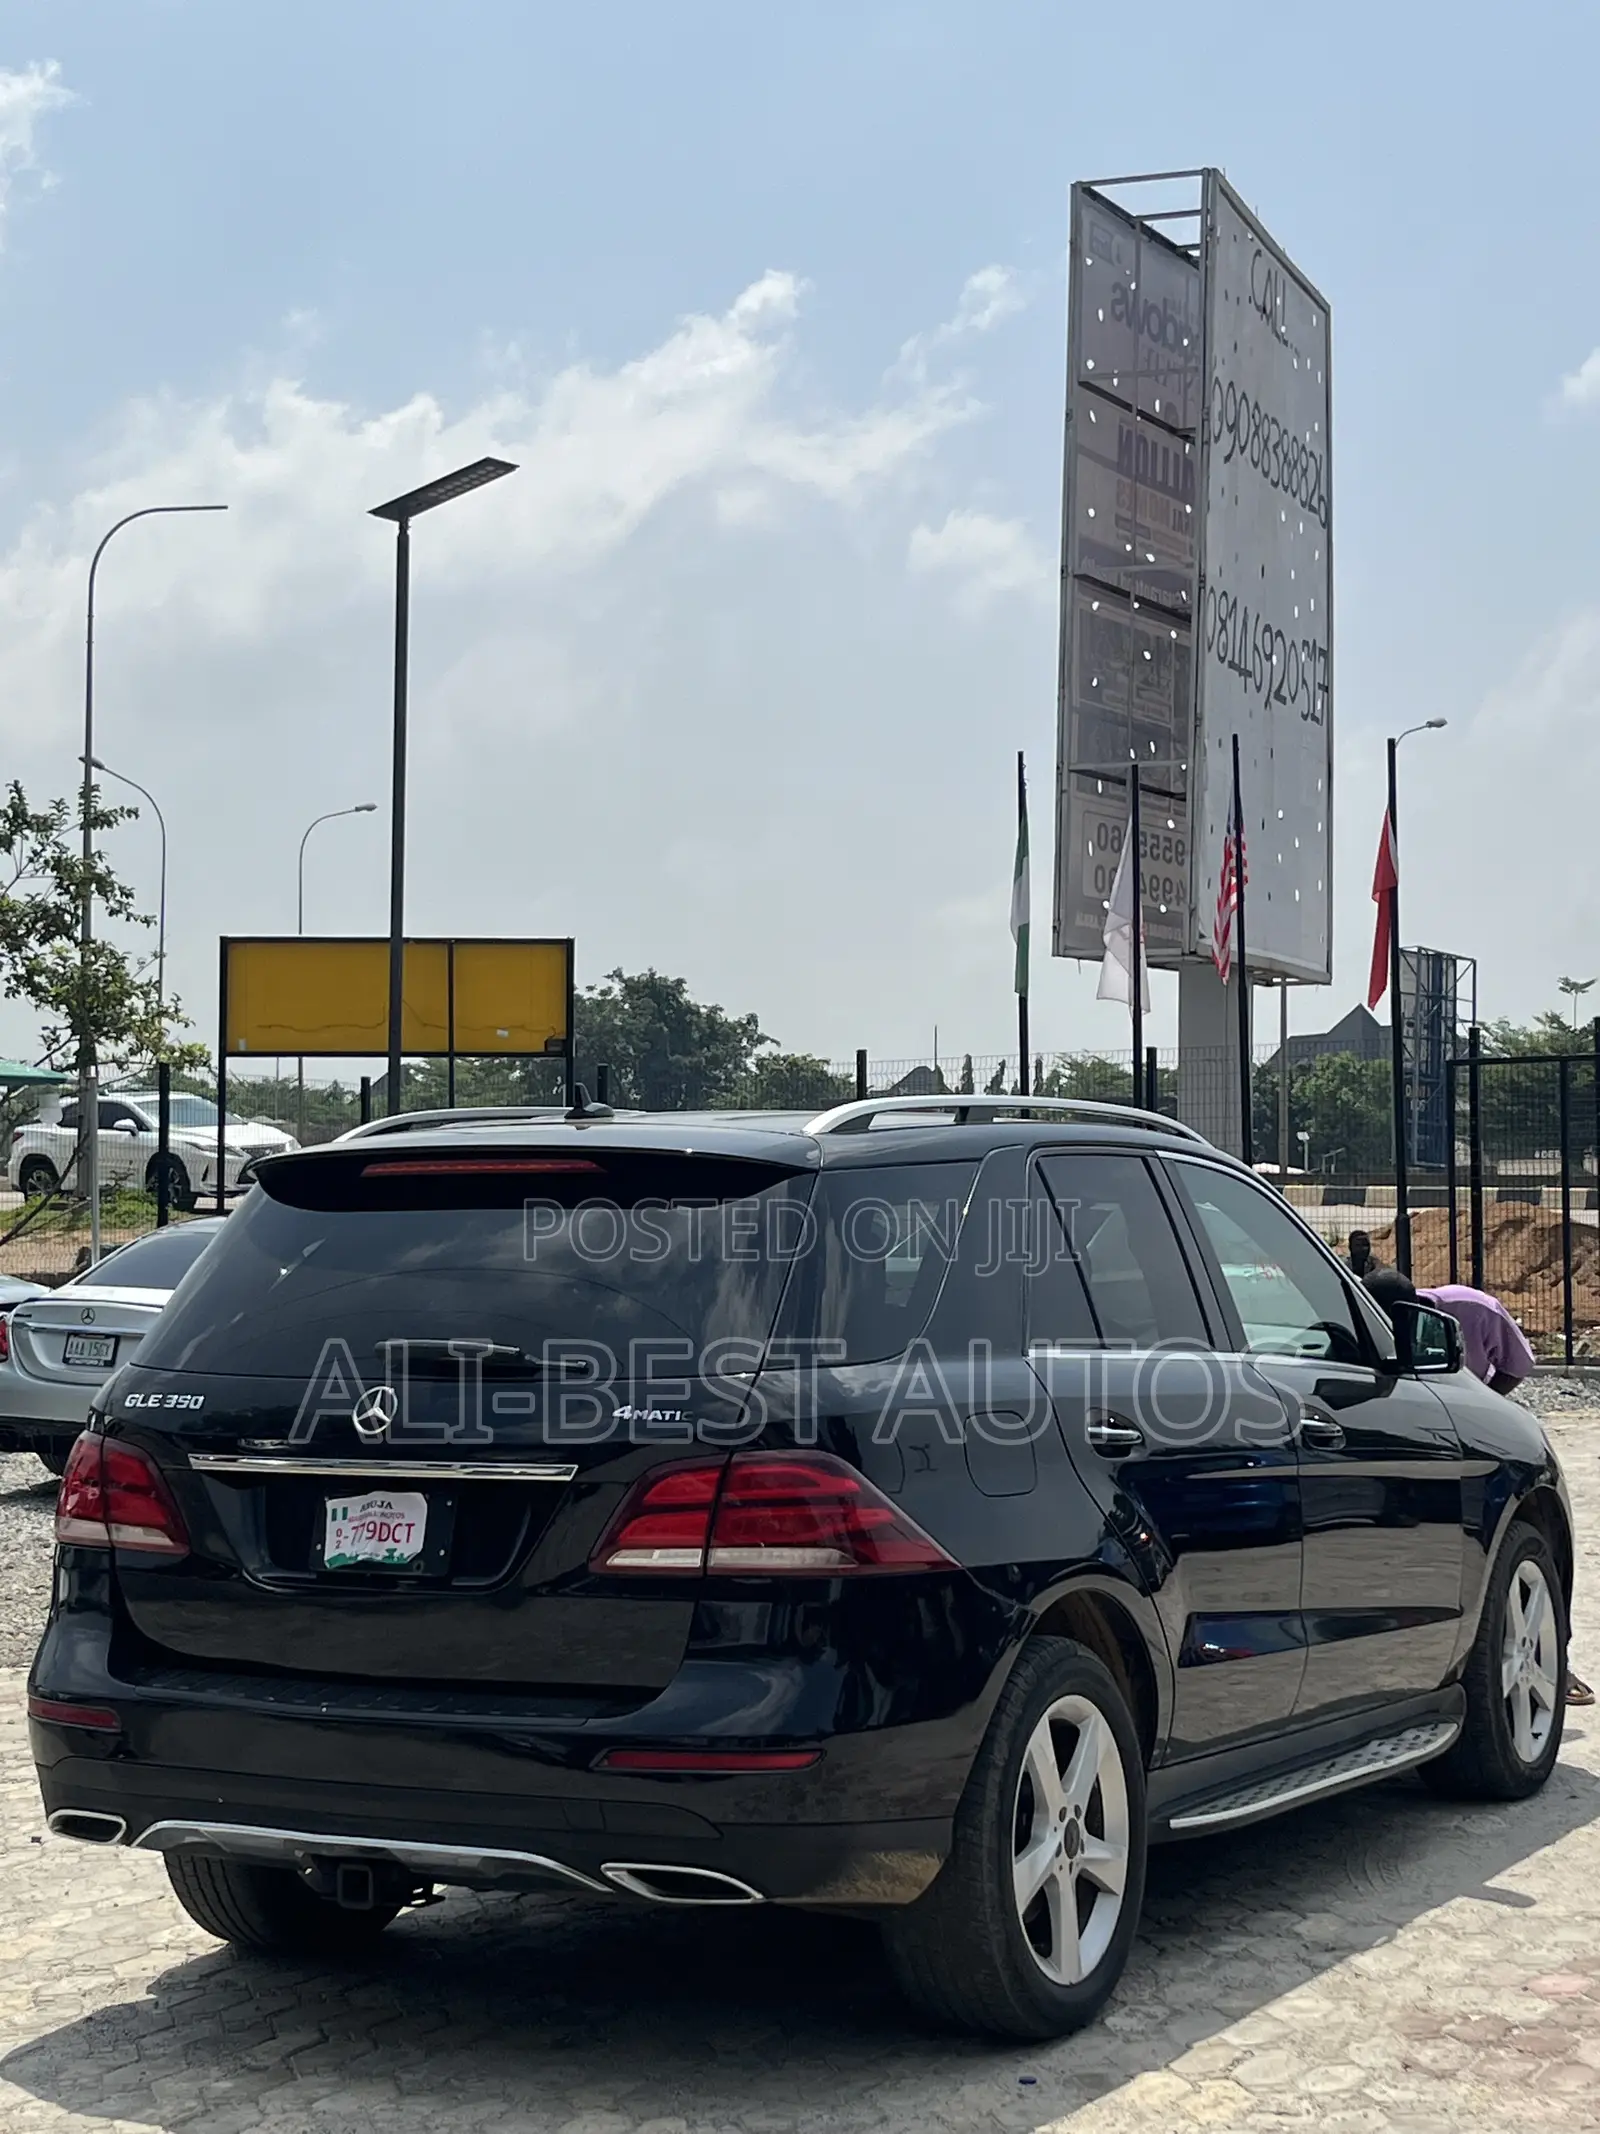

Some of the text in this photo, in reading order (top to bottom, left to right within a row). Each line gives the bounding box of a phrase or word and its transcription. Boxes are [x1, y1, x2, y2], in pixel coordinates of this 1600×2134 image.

[124, 1393, 205, 1410] GLE 350
[612, 1404, 694, 1421] 4MATIC
